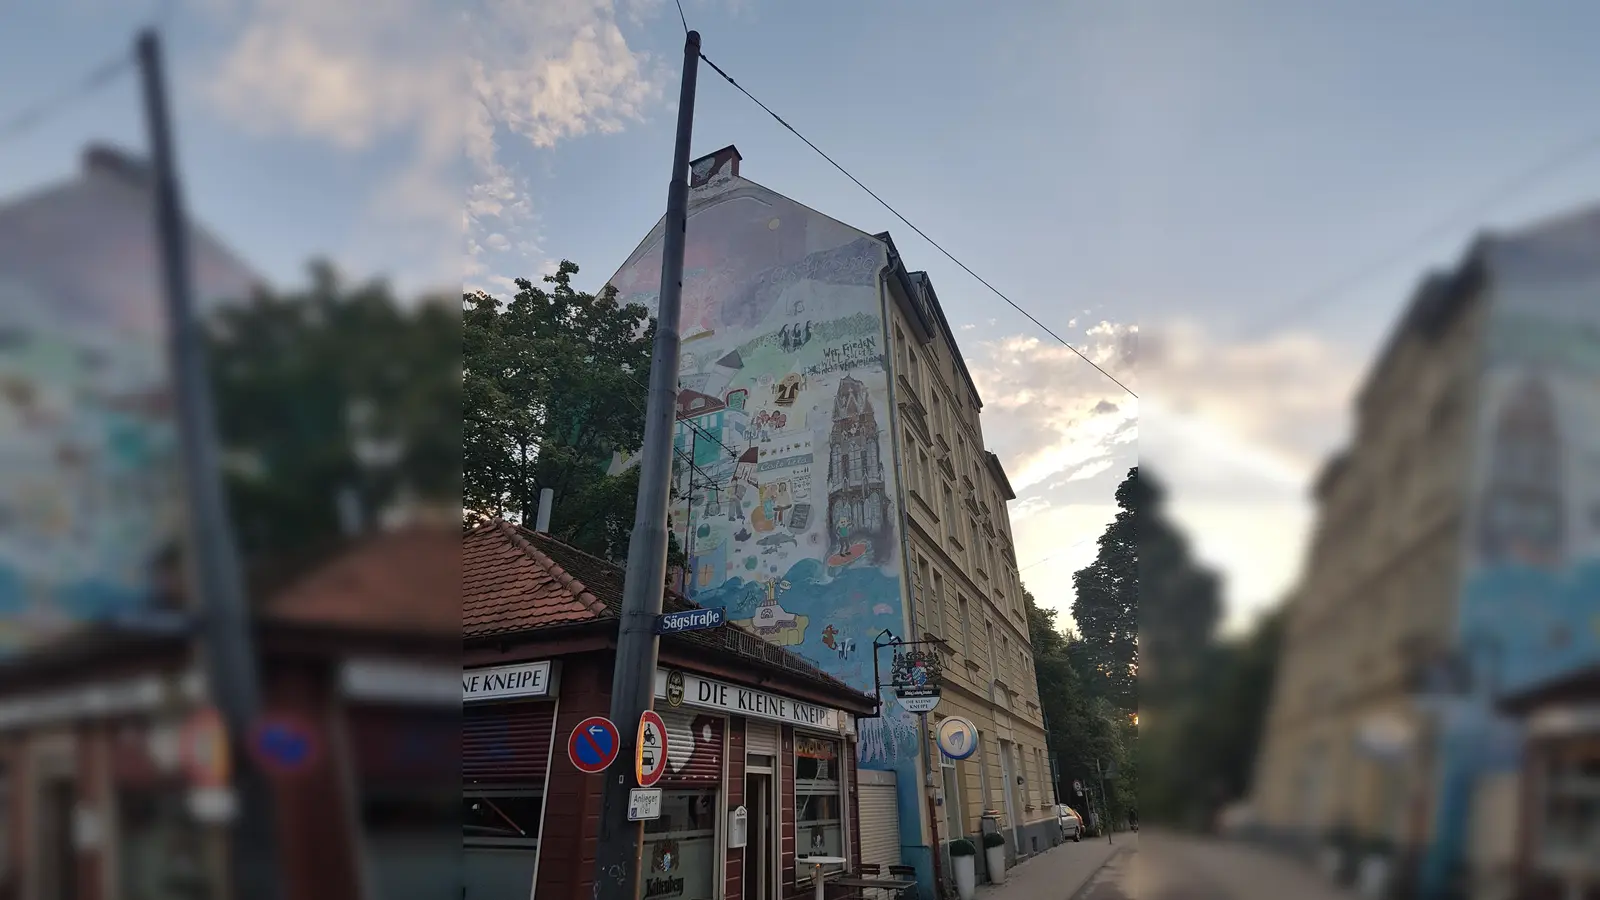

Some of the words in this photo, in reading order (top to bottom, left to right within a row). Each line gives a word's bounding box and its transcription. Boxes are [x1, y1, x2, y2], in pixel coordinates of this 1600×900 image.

[663, 610, 719, 630] Sägstraße
[483, 670, 542, 692] KNEIPE
[699, 681, 727, 706] DIE
[738, 690, 786, 717] KLEINE
[793, 702, 831, 726] KNEIPE
